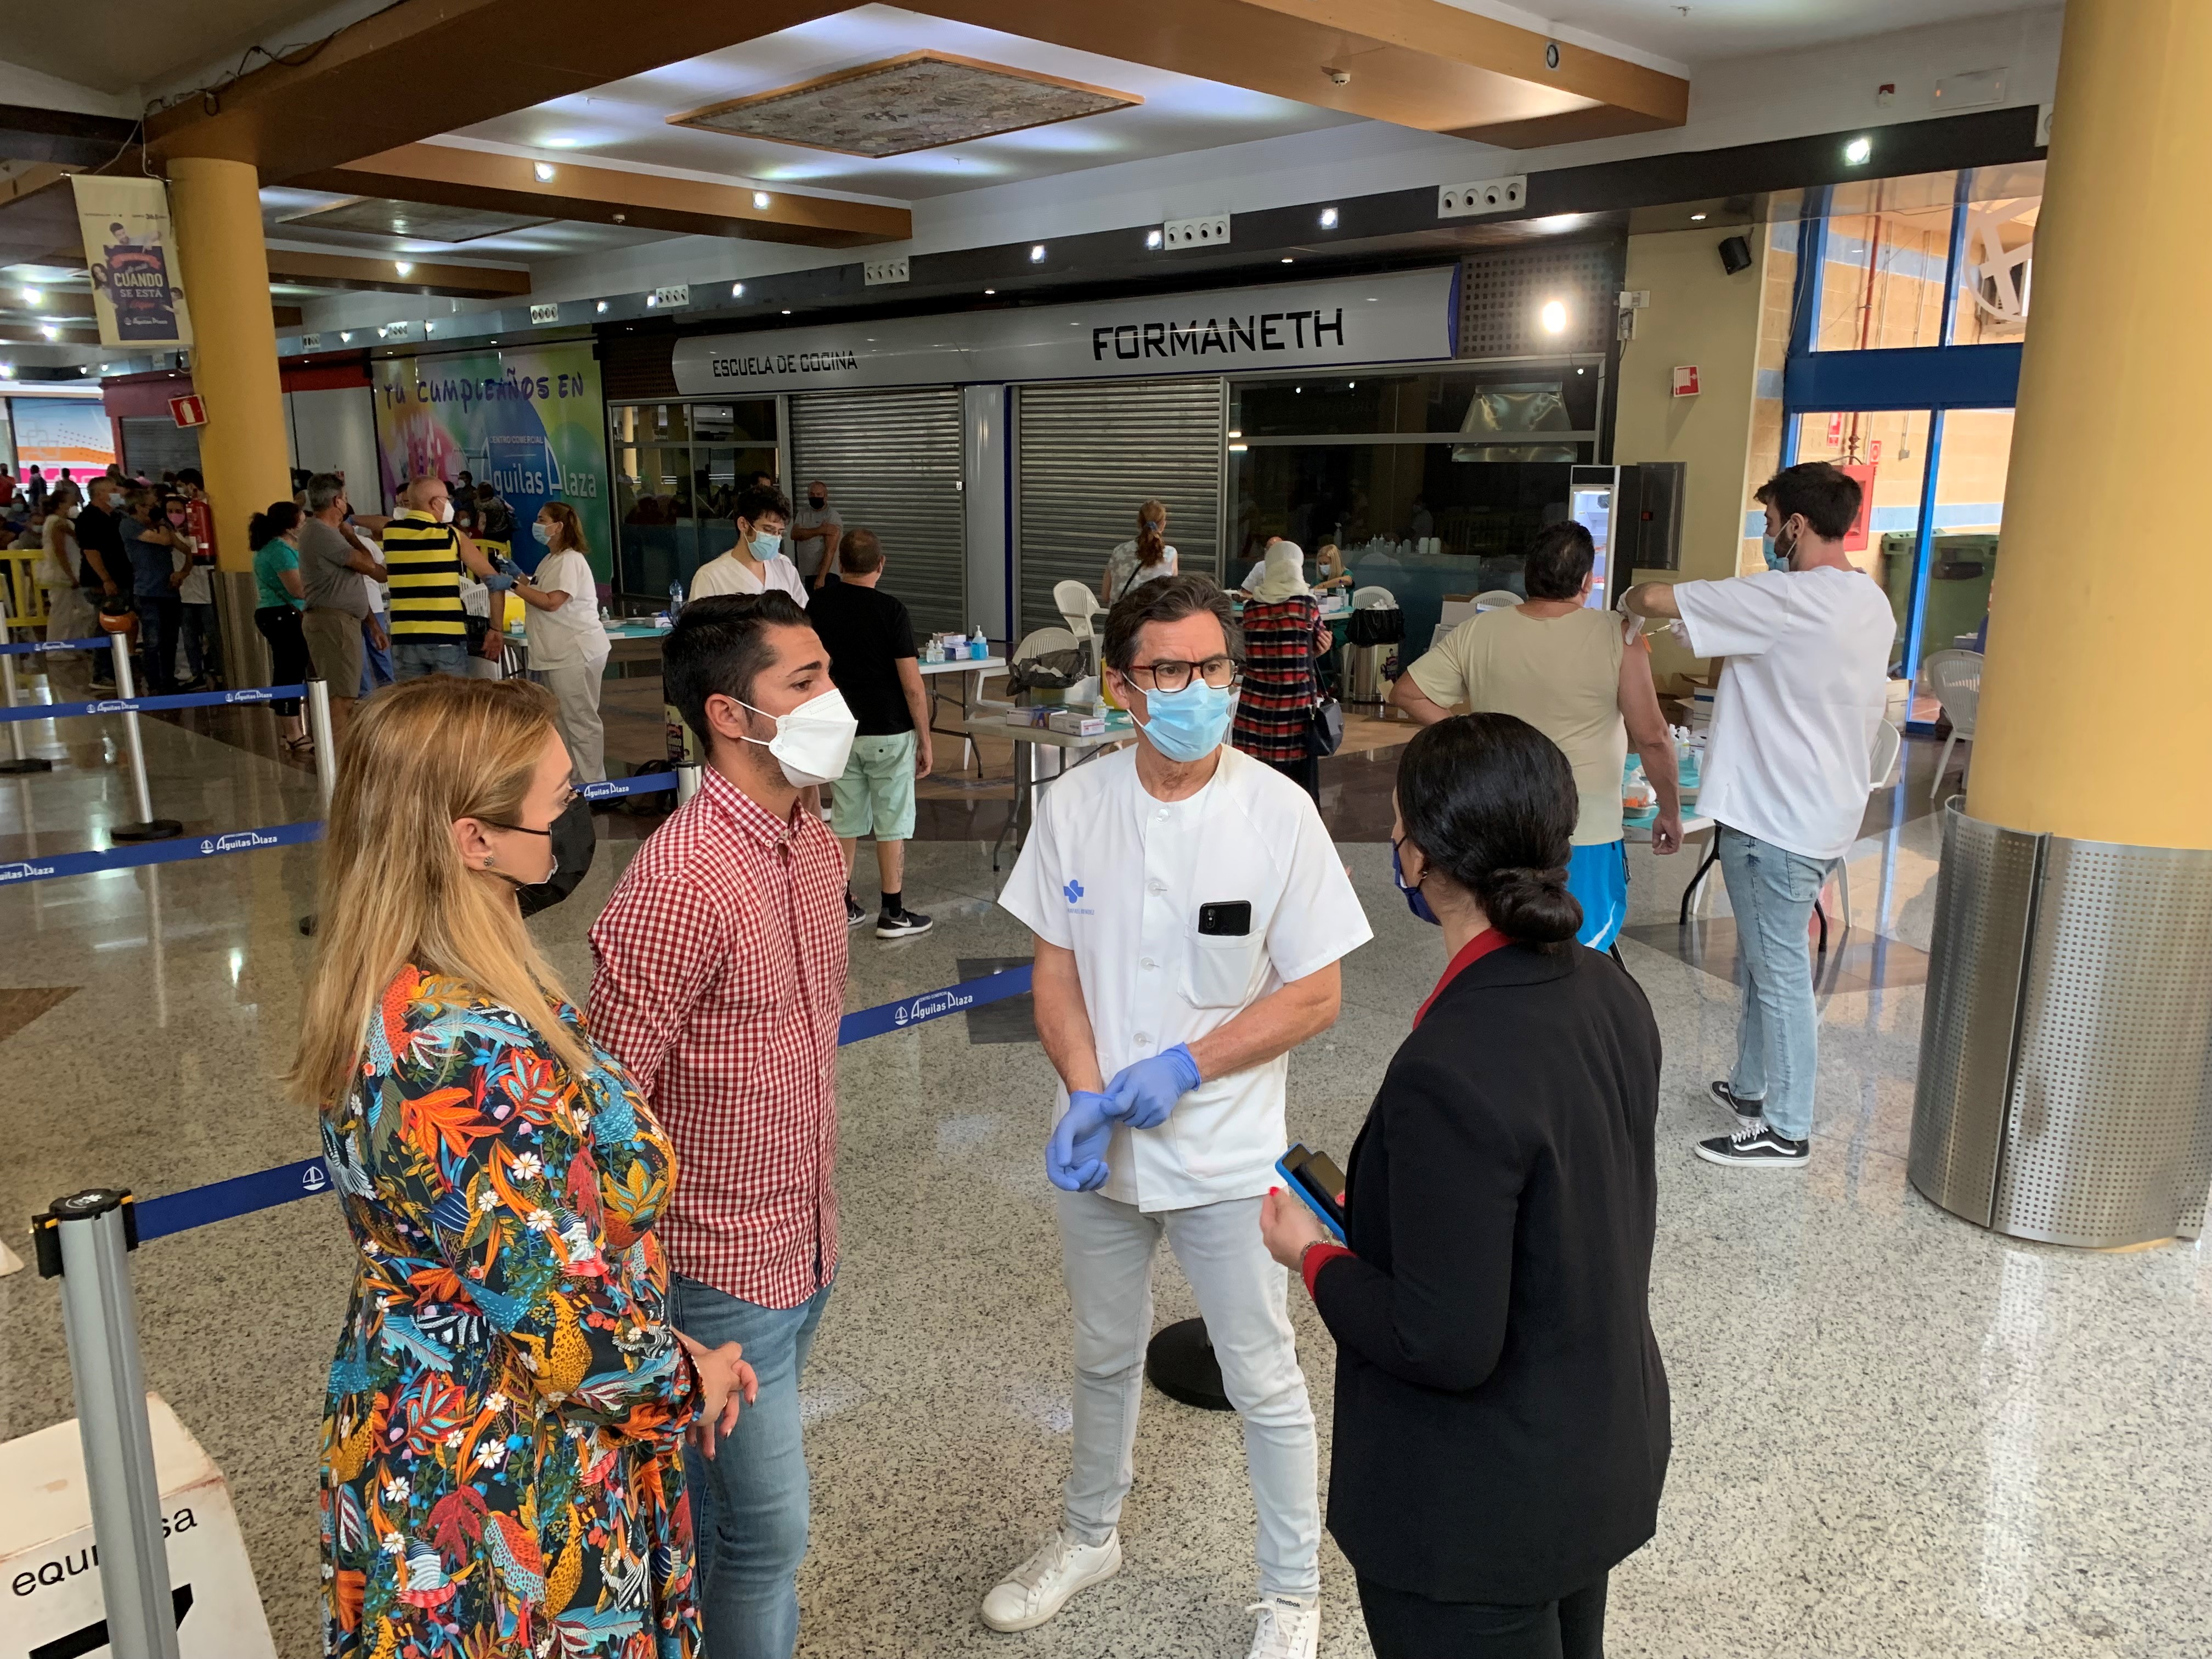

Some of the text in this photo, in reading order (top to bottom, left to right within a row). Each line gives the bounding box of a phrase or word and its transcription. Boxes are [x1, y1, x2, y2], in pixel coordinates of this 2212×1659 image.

[114, 272, 164, 287] CUANDO
[120, 289, 133, 297] SE
[1093, 308, 1344, 361] FORMANETH
[713, 350, 858, 377] ESCUELA DE COCINA
[384, 366, 584, 414] TU CUMPLEAÑOS EN
[1276, 1597, 1301, 1609] Reebok
